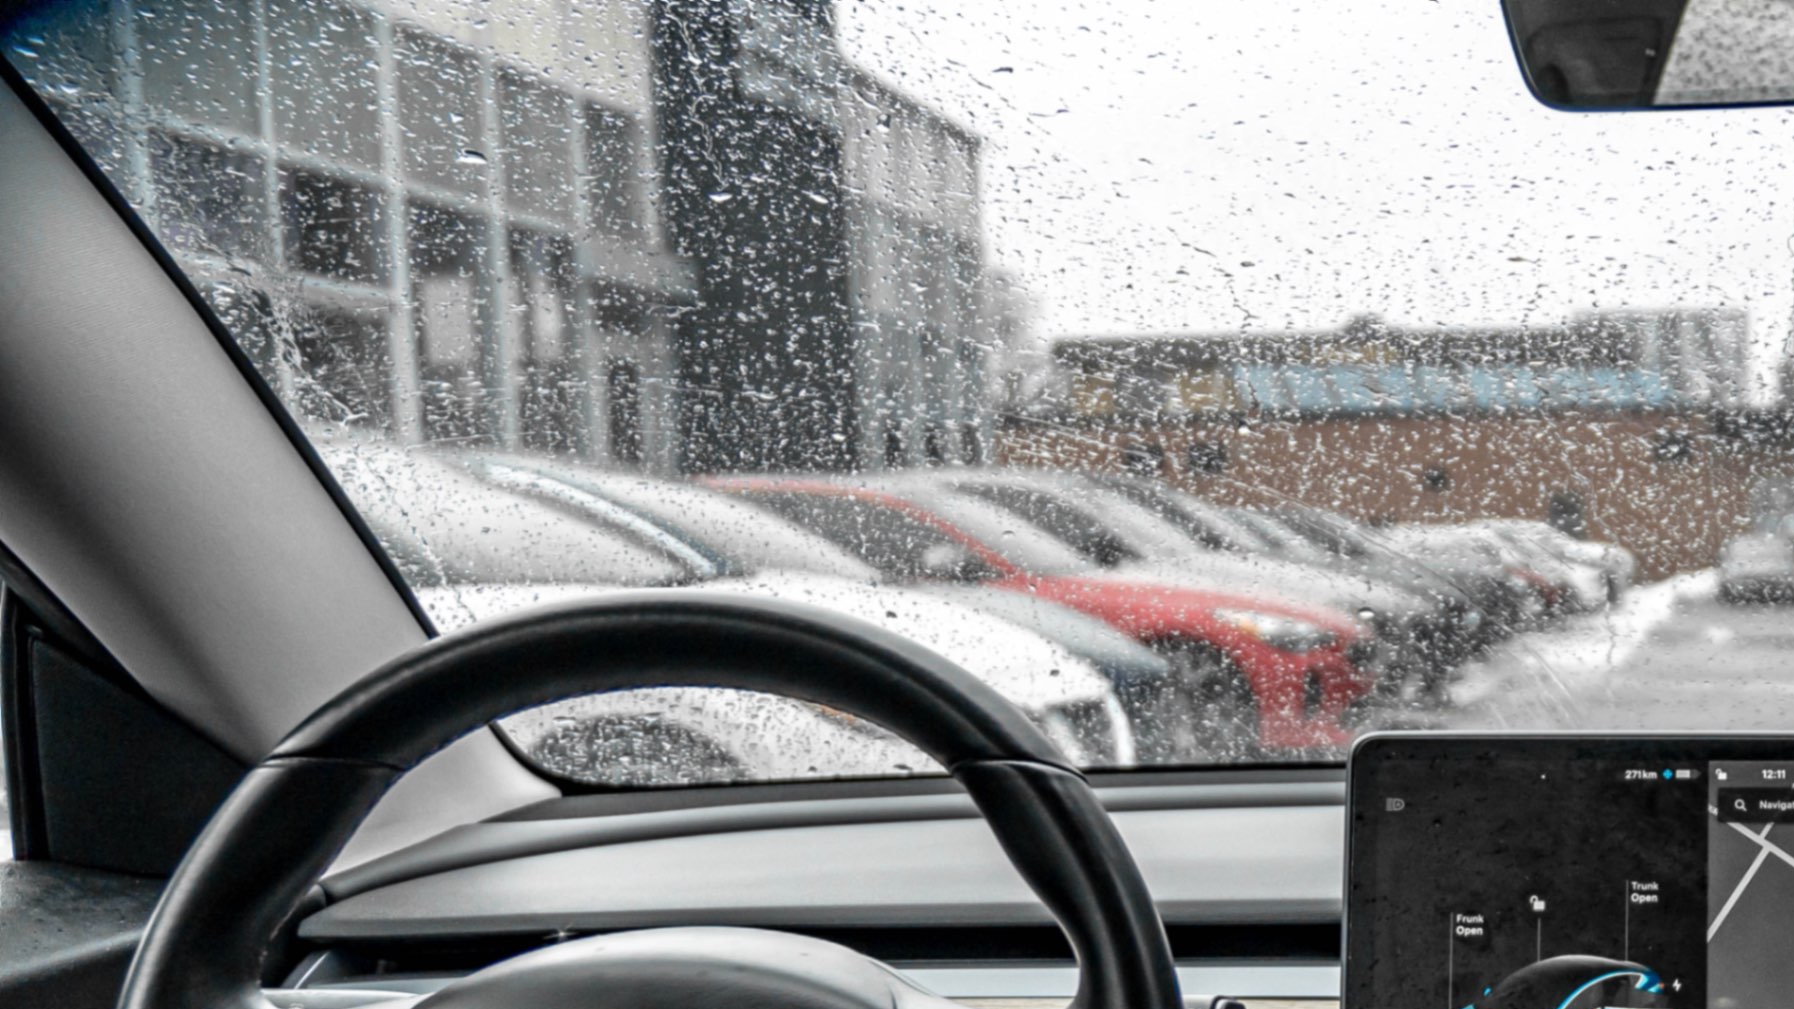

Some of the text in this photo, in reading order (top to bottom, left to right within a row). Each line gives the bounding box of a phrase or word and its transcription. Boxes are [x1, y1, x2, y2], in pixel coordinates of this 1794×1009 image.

[1761, 769, 1786, 779] 12:11
[1631, 881, 1659, 891] Trunk
[1630, 892, 1659, 904] Open
[1456, 913, 1484, 924] Frunk
[1456, 925, 1484, 937] Open
